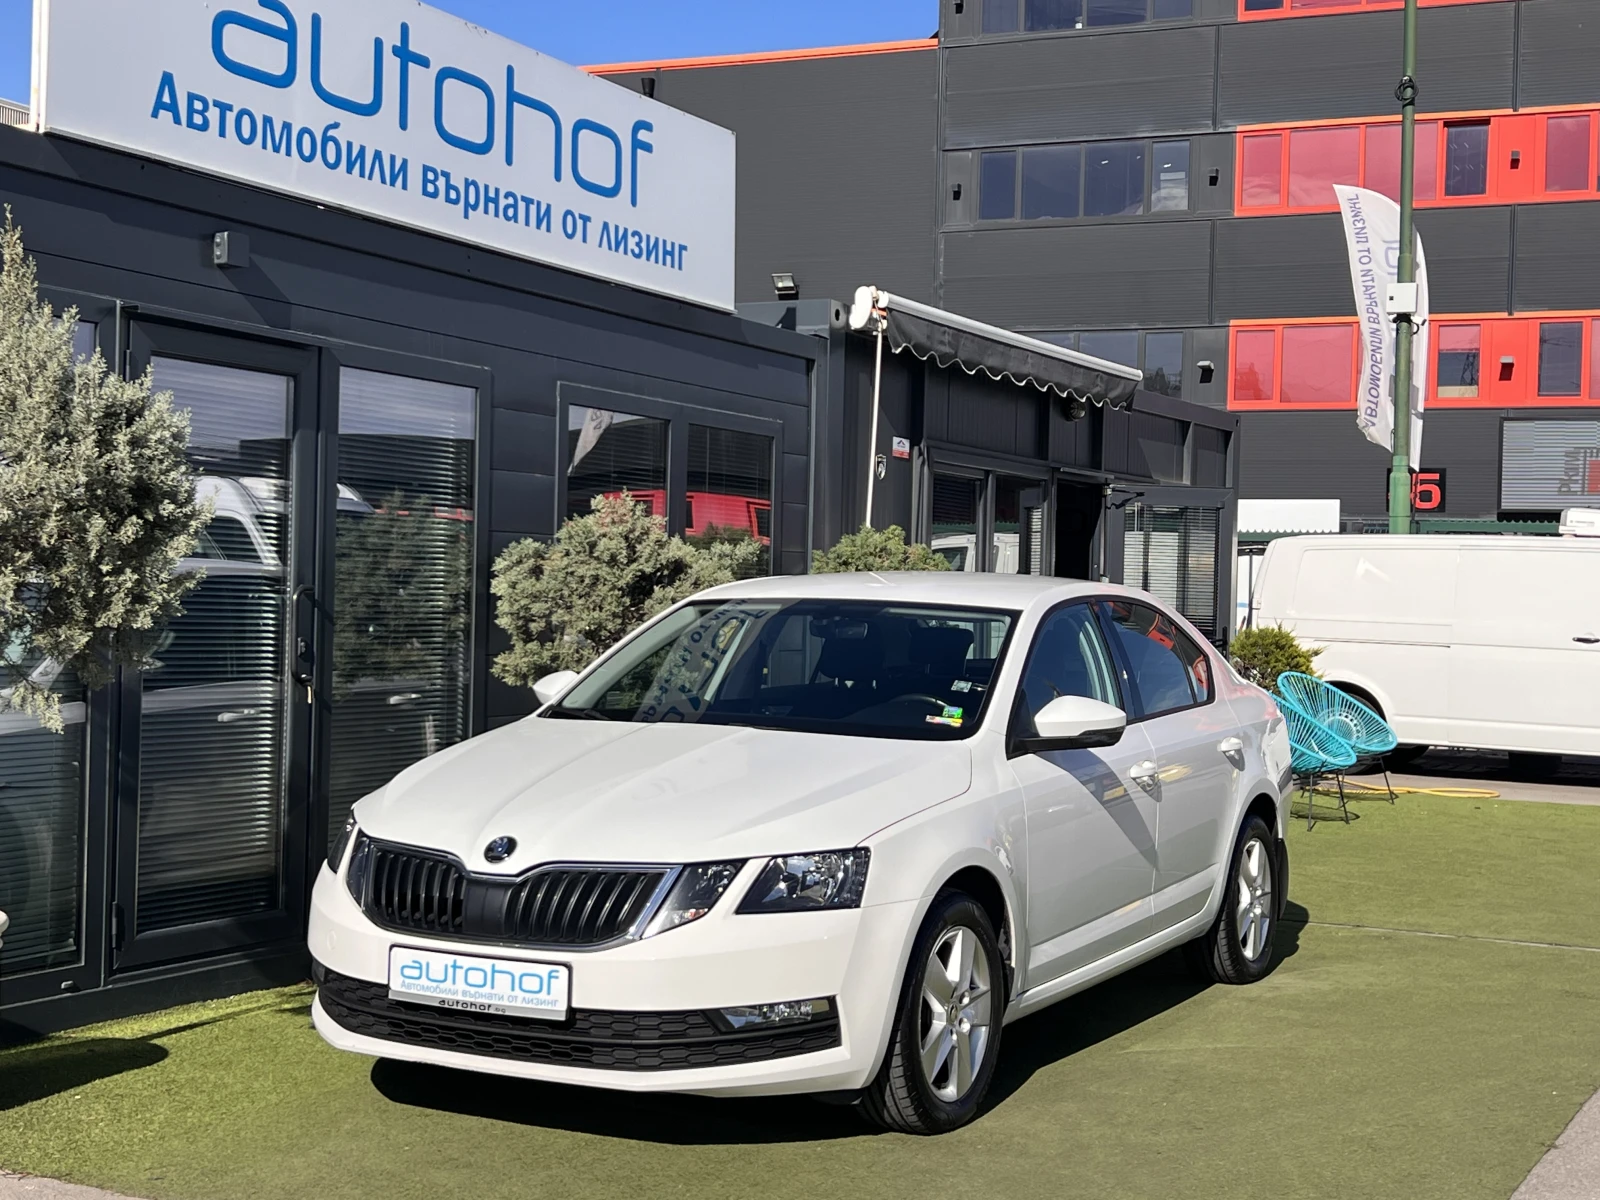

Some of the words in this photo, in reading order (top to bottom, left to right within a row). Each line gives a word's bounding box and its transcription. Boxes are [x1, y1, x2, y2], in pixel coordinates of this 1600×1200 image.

[210, 0, 654, 207] autohof
[151, 70, 408, 191] Автомобили
[421, 163, 552, 234] върнати
[561, 208, 592, 244] от
[598, 220, 688, 271] лизинг
[400, 959, 560, 996] autohof
[400, 979, 459, 998] Автомобили
[462, 989, 504, 1002] върнати
[507, 995, 519, 1004] от
[520, 997, 560, 1008] лизинг
